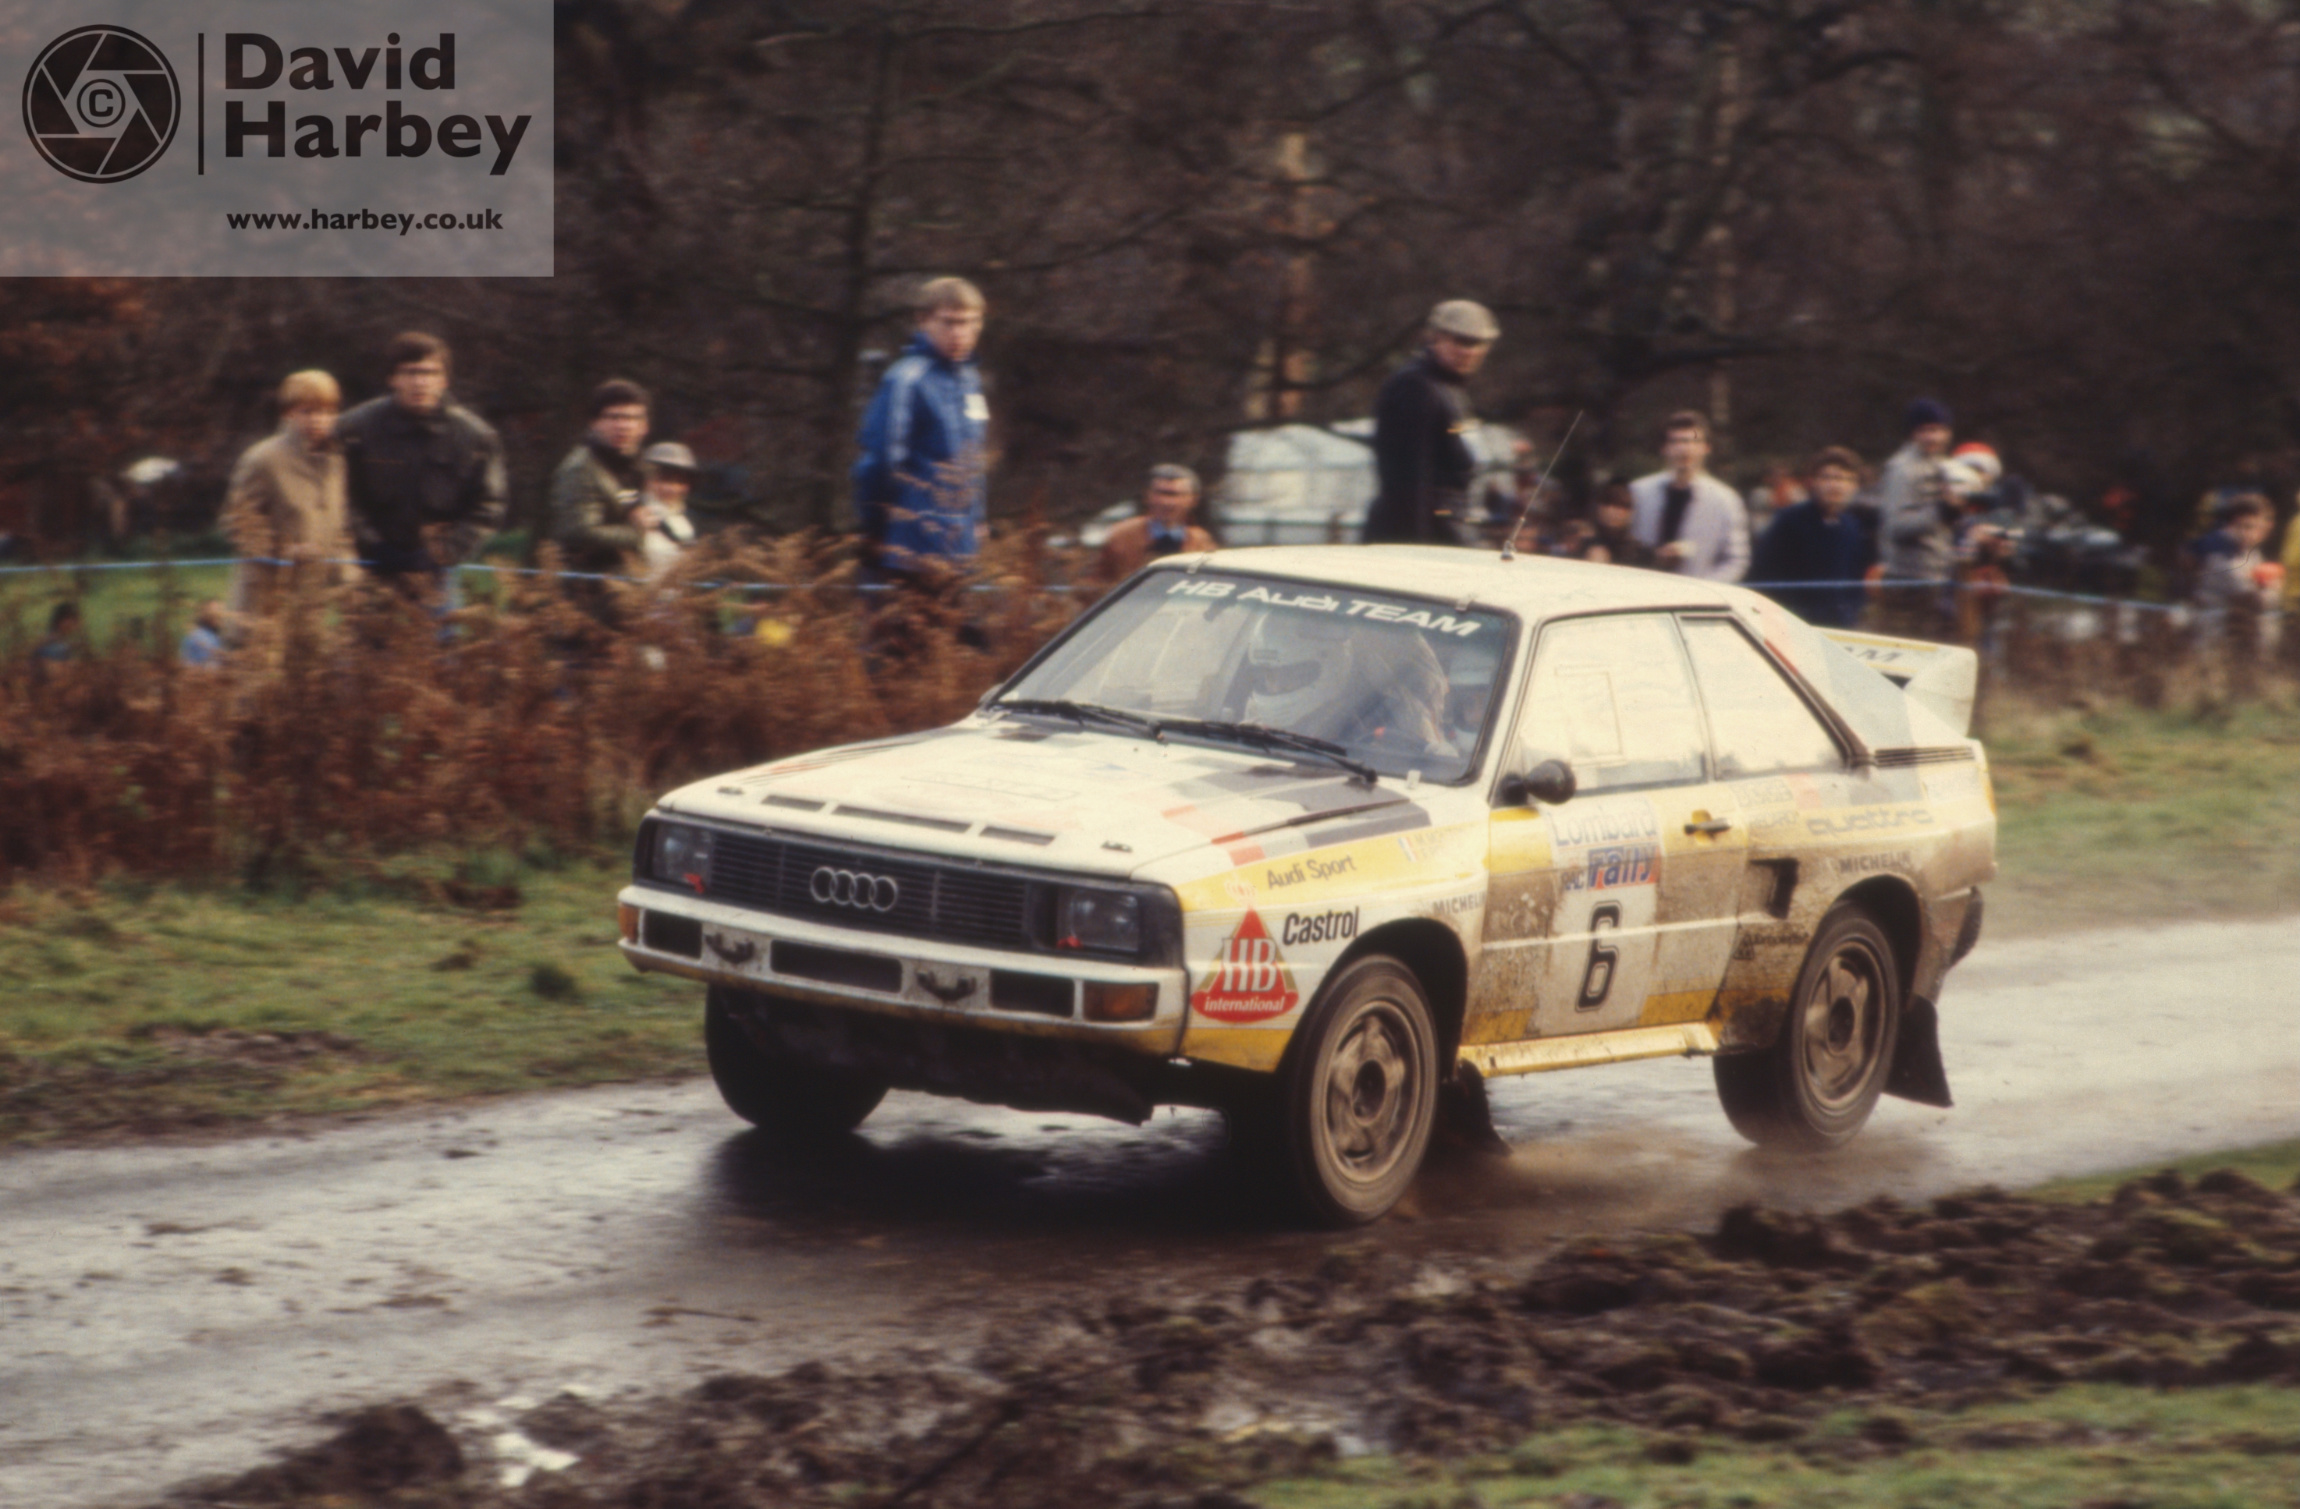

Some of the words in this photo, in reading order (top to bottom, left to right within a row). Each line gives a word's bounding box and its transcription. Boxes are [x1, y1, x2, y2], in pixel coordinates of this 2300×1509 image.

[1165, 579, 1237, 599] HB
[1343, 600, 1481, 638] TEAM
[1550, 800, 1657, 846] Lombard
[1805, 808, 1934, 838] quattro
[1267, 863, 1306, 890] Audi
[1307, 855, 1357, 880] Sport
[1588, 846, 1657, 888] rally
[1283, 906, 1360, 945] Castrol
[1221, 937, 1277, 992] HB
[1575, 900, 1622, 1013] 6
[1204, 996, 1285, 1014] international
